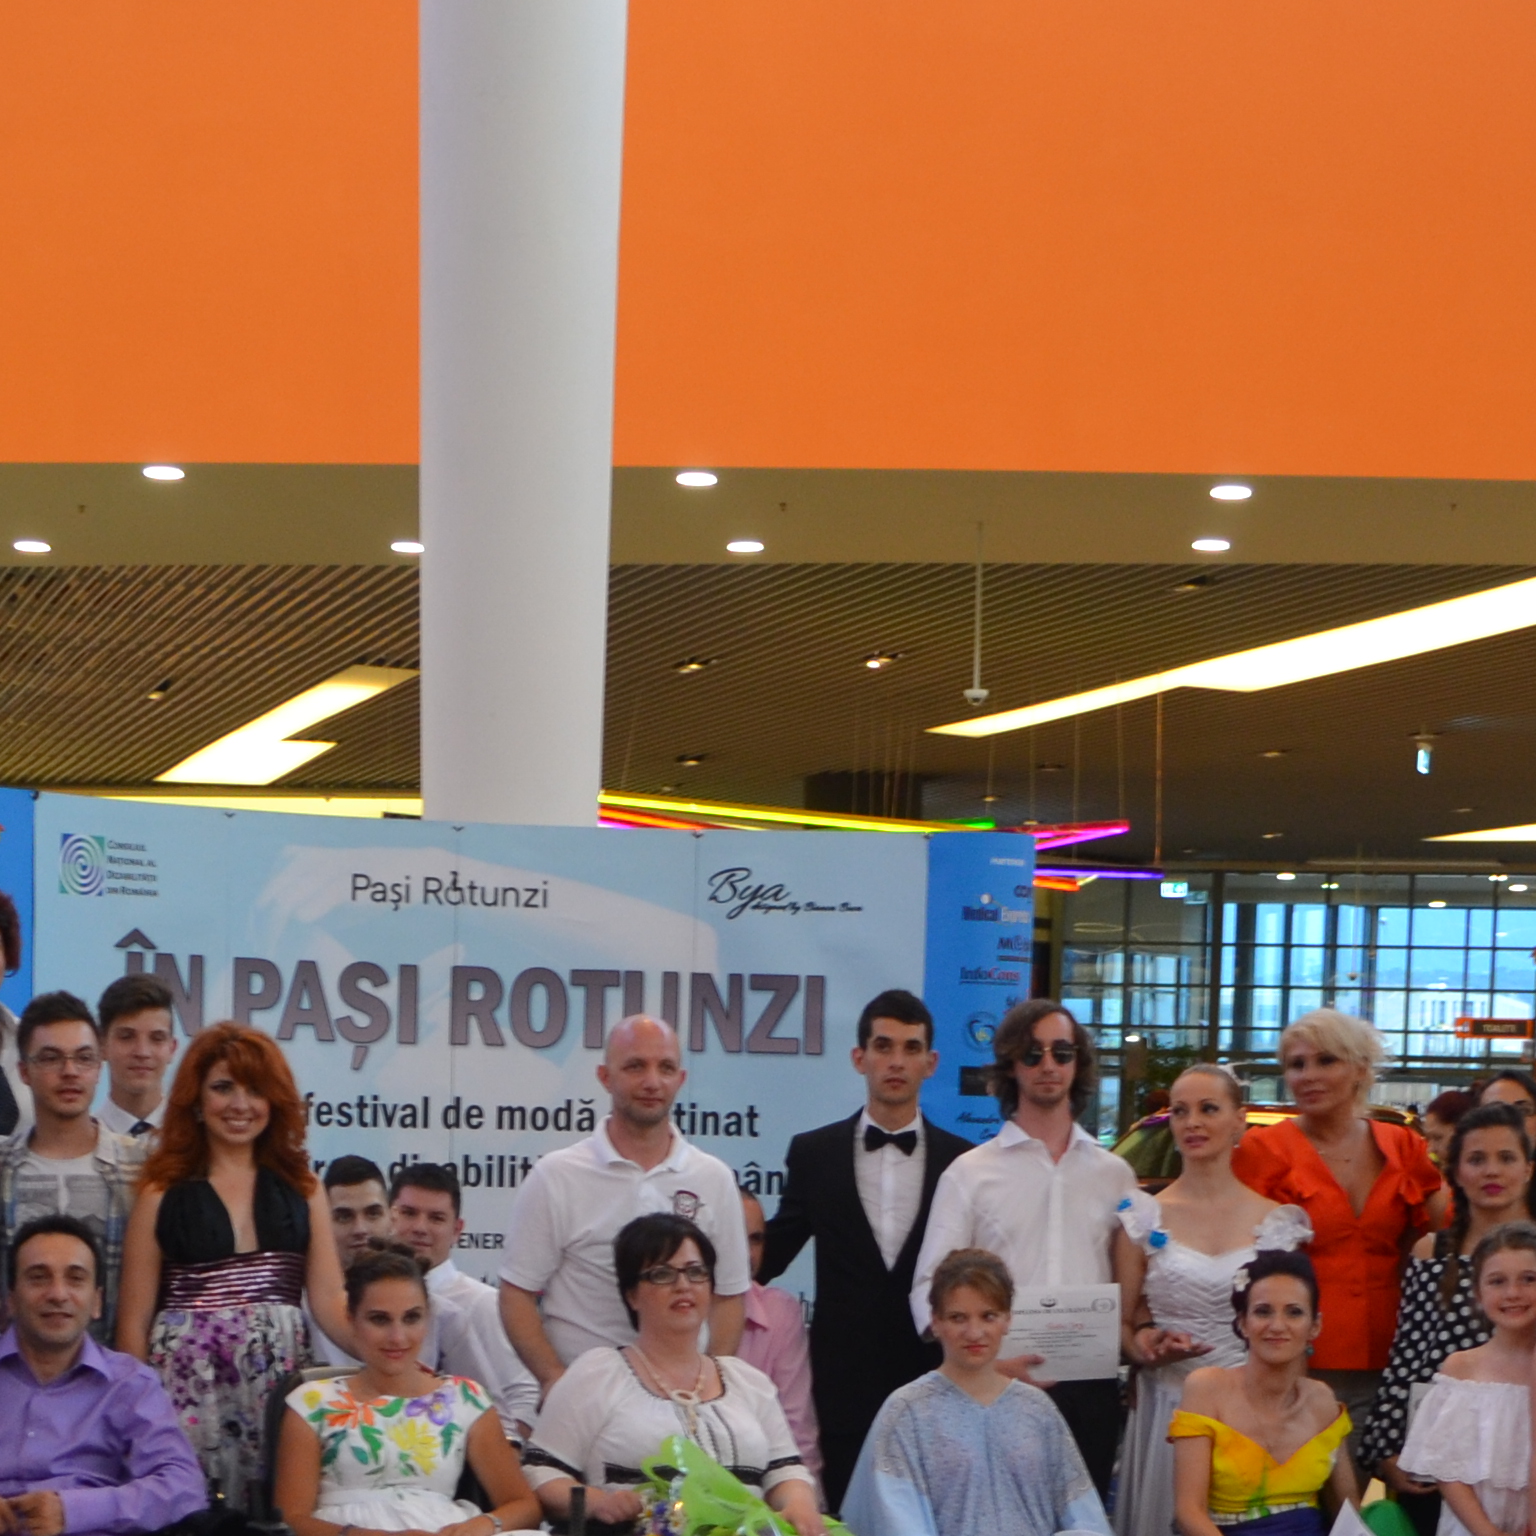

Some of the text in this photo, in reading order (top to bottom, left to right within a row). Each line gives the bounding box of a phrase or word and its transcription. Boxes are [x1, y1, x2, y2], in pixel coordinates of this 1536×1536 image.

[351, 871, 549, 911] Pași Rotunzi
[708, 867, 791, 919] Bya
[233, 956, 420, 1071] PAȘI
[450, 965, 826, 1056] ROTUNZI
[305, 1092, 429, 1129] festival
[442, 1096, 484, 1130] de
[496, 1098, 595, 1132] modă
